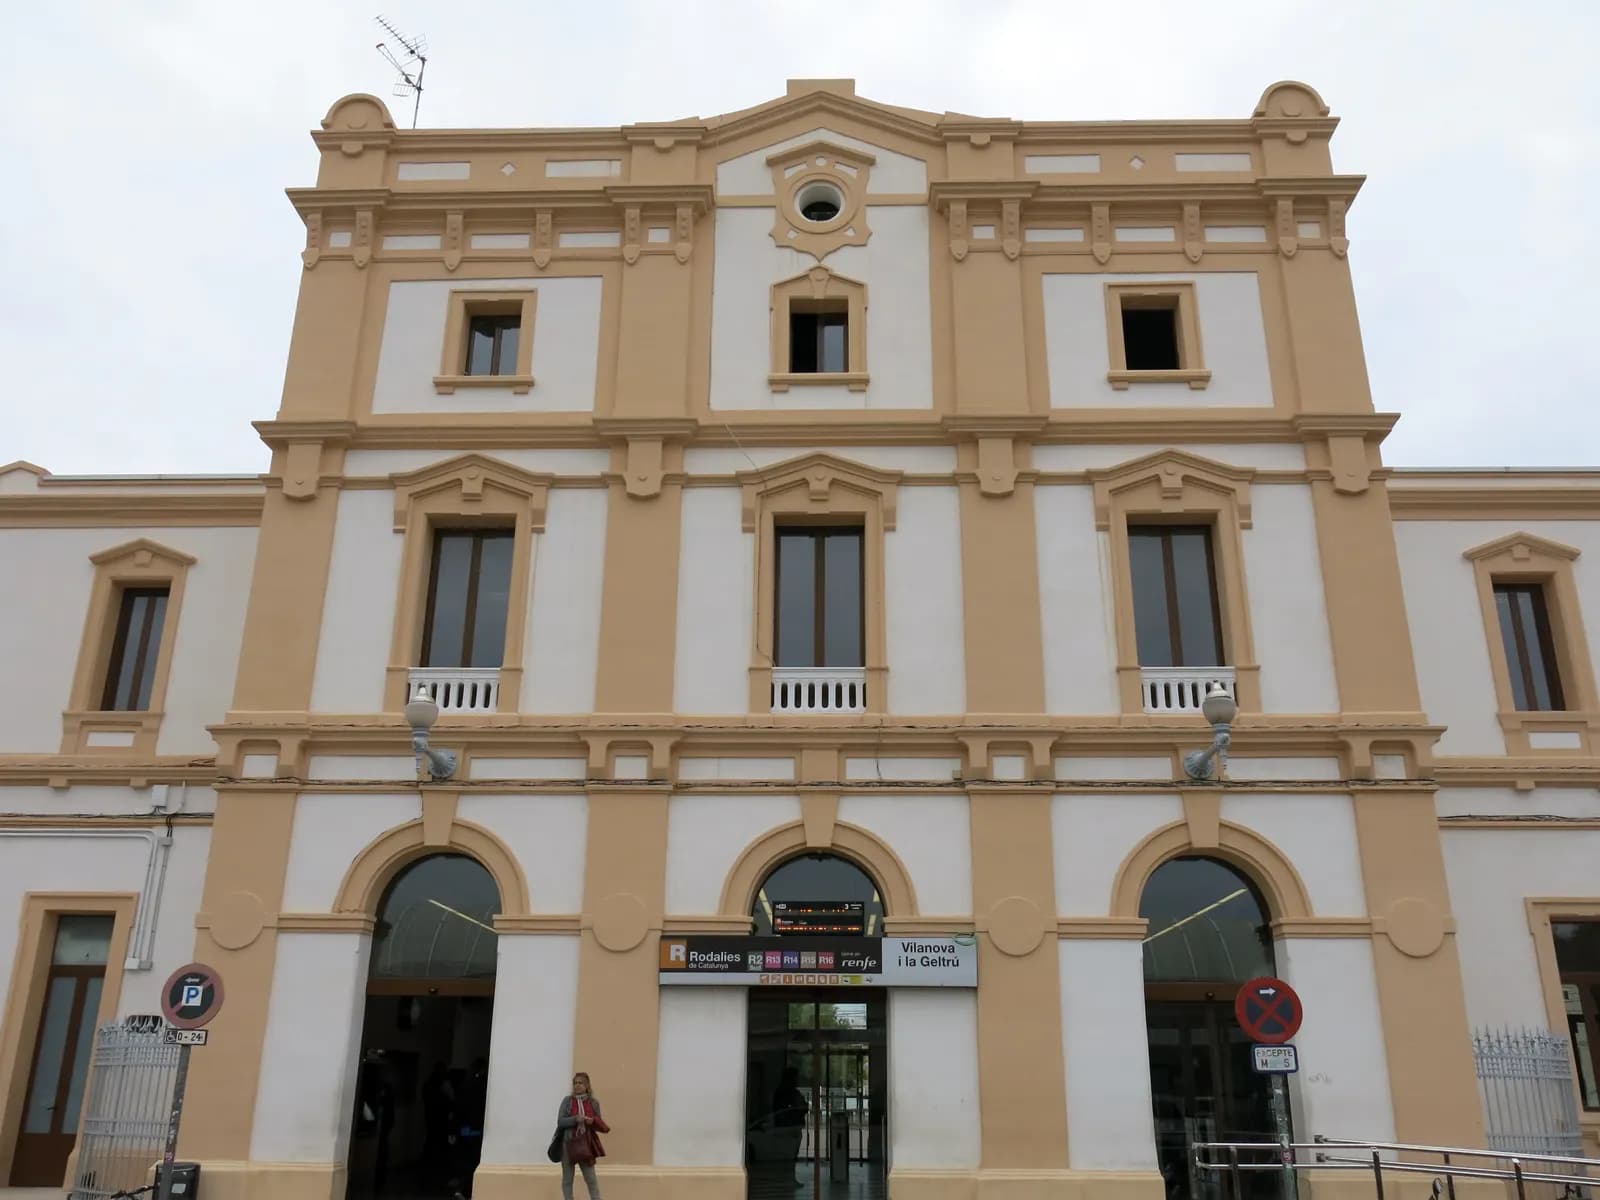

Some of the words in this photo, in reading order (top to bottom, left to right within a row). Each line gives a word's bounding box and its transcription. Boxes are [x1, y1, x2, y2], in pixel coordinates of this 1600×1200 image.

[670, 944, 686, 961] R
[901, 942, 955, 953] Vilanova
[689, 951, 741, 962] Rodalies
[748, 954, 763, 965] R2
[765, 957, 781, 965] R13
[783, 957, 799, 965] R14
[801, 957, 817, 965] R15
[818, 957, 834, 965] R16
[898, 956, 902, 967] i
[905, 956, 916, 967] la
[920, 955, 960, 967] Geltrú
[698, 962, 729, 970] Catalunya
[841, 956, 877, 970] renfe
[185, 987, 199, 1004] P
